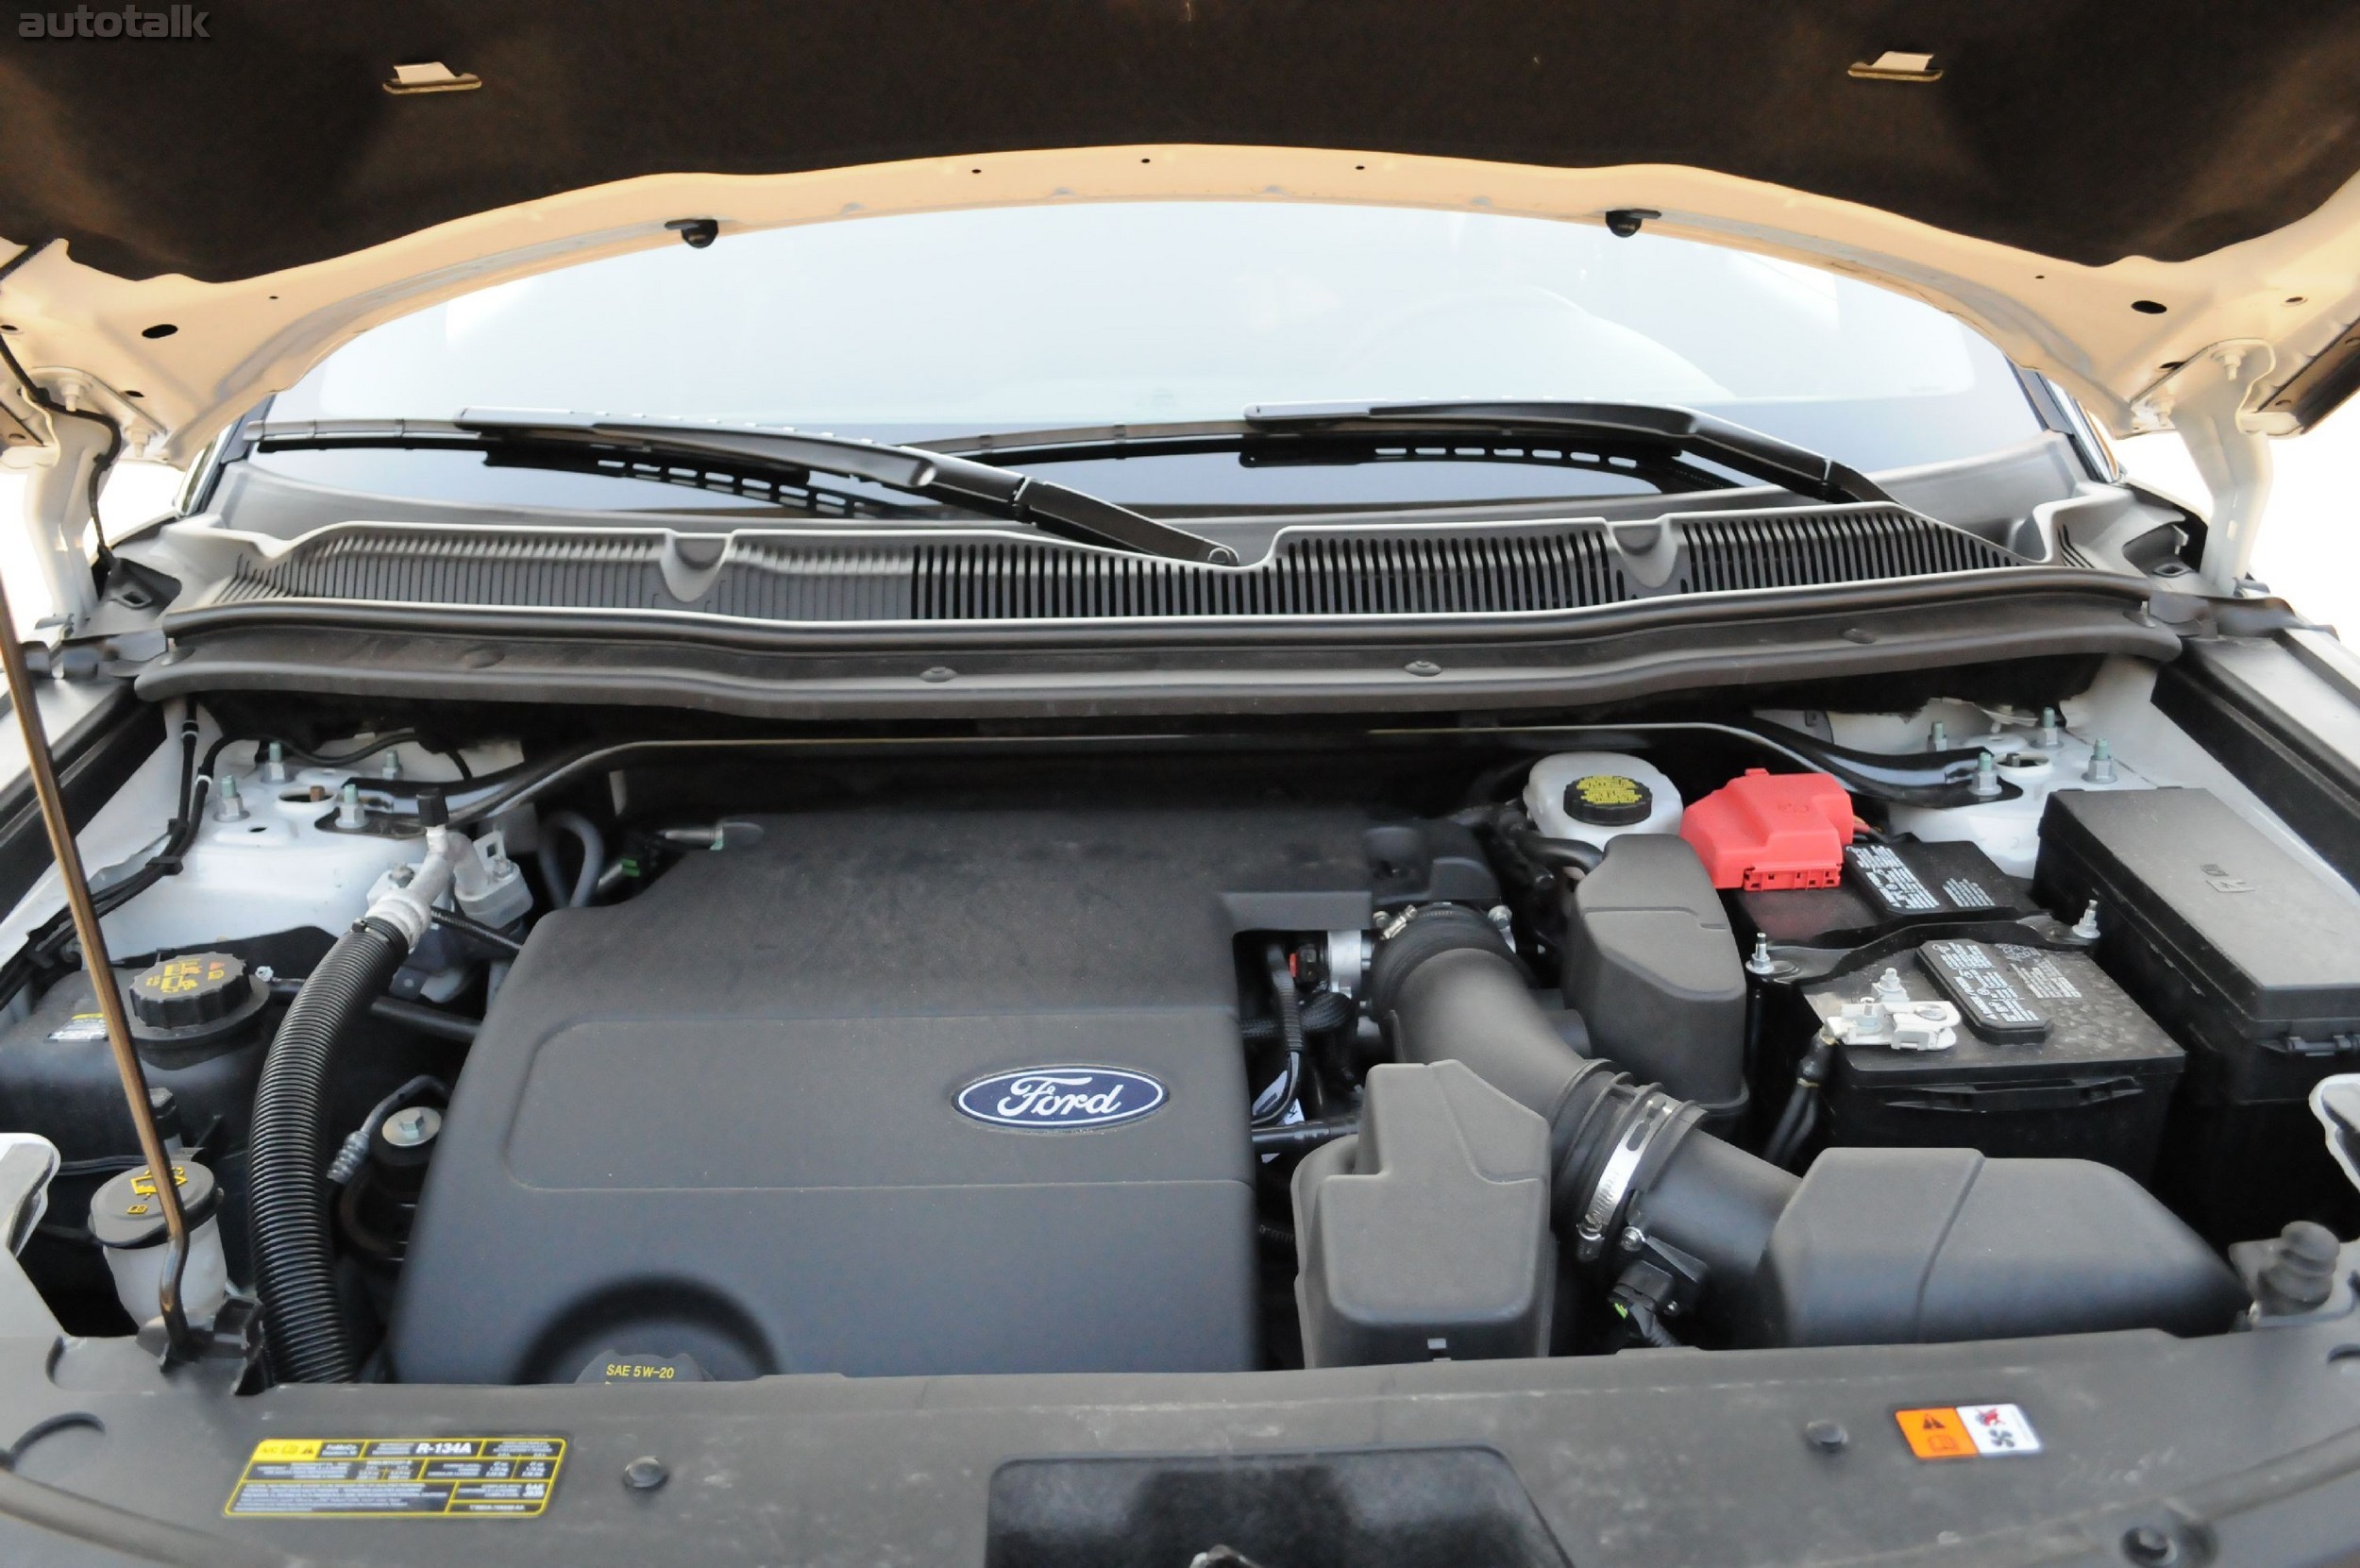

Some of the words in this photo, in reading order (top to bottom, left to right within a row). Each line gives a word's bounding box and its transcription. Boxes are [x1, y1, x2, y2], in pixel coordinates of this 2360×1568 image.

[997, 1076, 1123, 1116] Ford
[606, 1364, 632, 1376] SAE
[633, 1366, 674, 1378] 5W-20
[415, 1442, 472, 1455] R-134A
